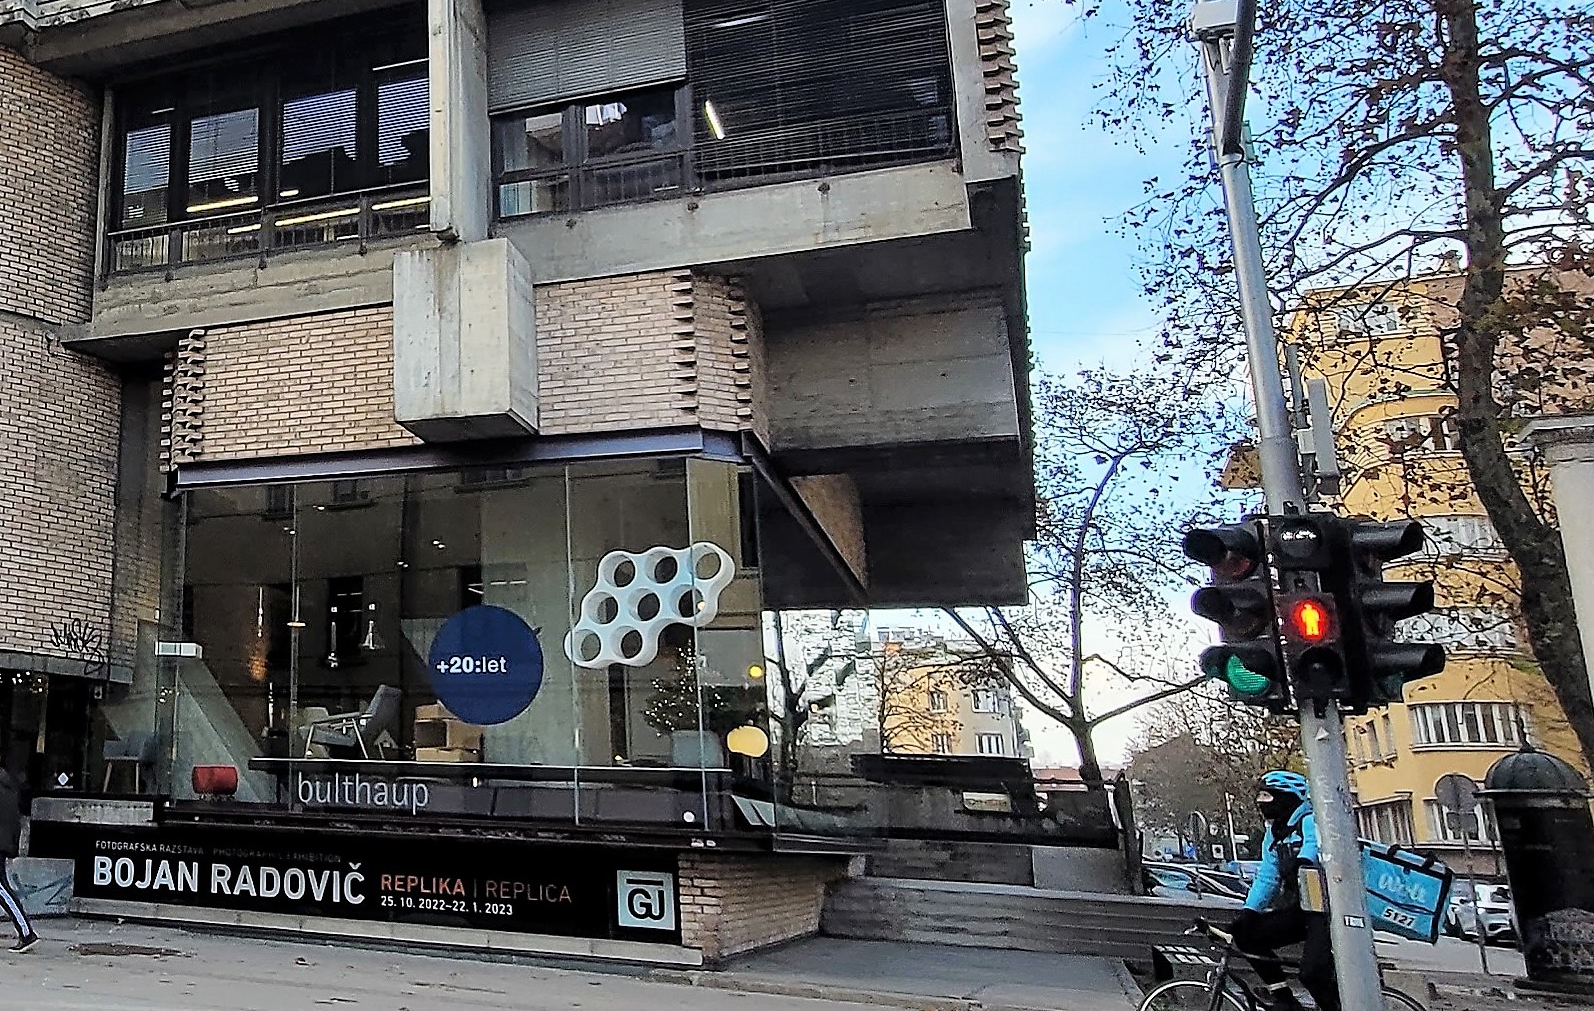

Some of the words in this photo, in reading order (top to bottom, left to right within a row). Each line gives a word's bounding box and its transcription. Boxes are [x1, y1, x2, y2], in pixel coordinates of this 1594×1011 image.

[436, 656, 507, 674] +20:let
[298, 771, 429, 816] bulthaup
[95, 840, 157, 852] FOTOGRAFSKA
[159, 844, 204, 855] RAZSTAVA
[93, 855, 198, 893] BOJAN
[210, 861, 365, 905] RADOVIČ
[381, 874, 465, 897] REPLIKA
[485, 880, 573, 904] REPLICA
[380, 895, 397, 908] 25.
[400, 897, 415, 909] 10.
[473, 902, 482, 914] 1.
[485, 903, 513, 916] 2023
[1384, 908, 1415, 927] 5127
